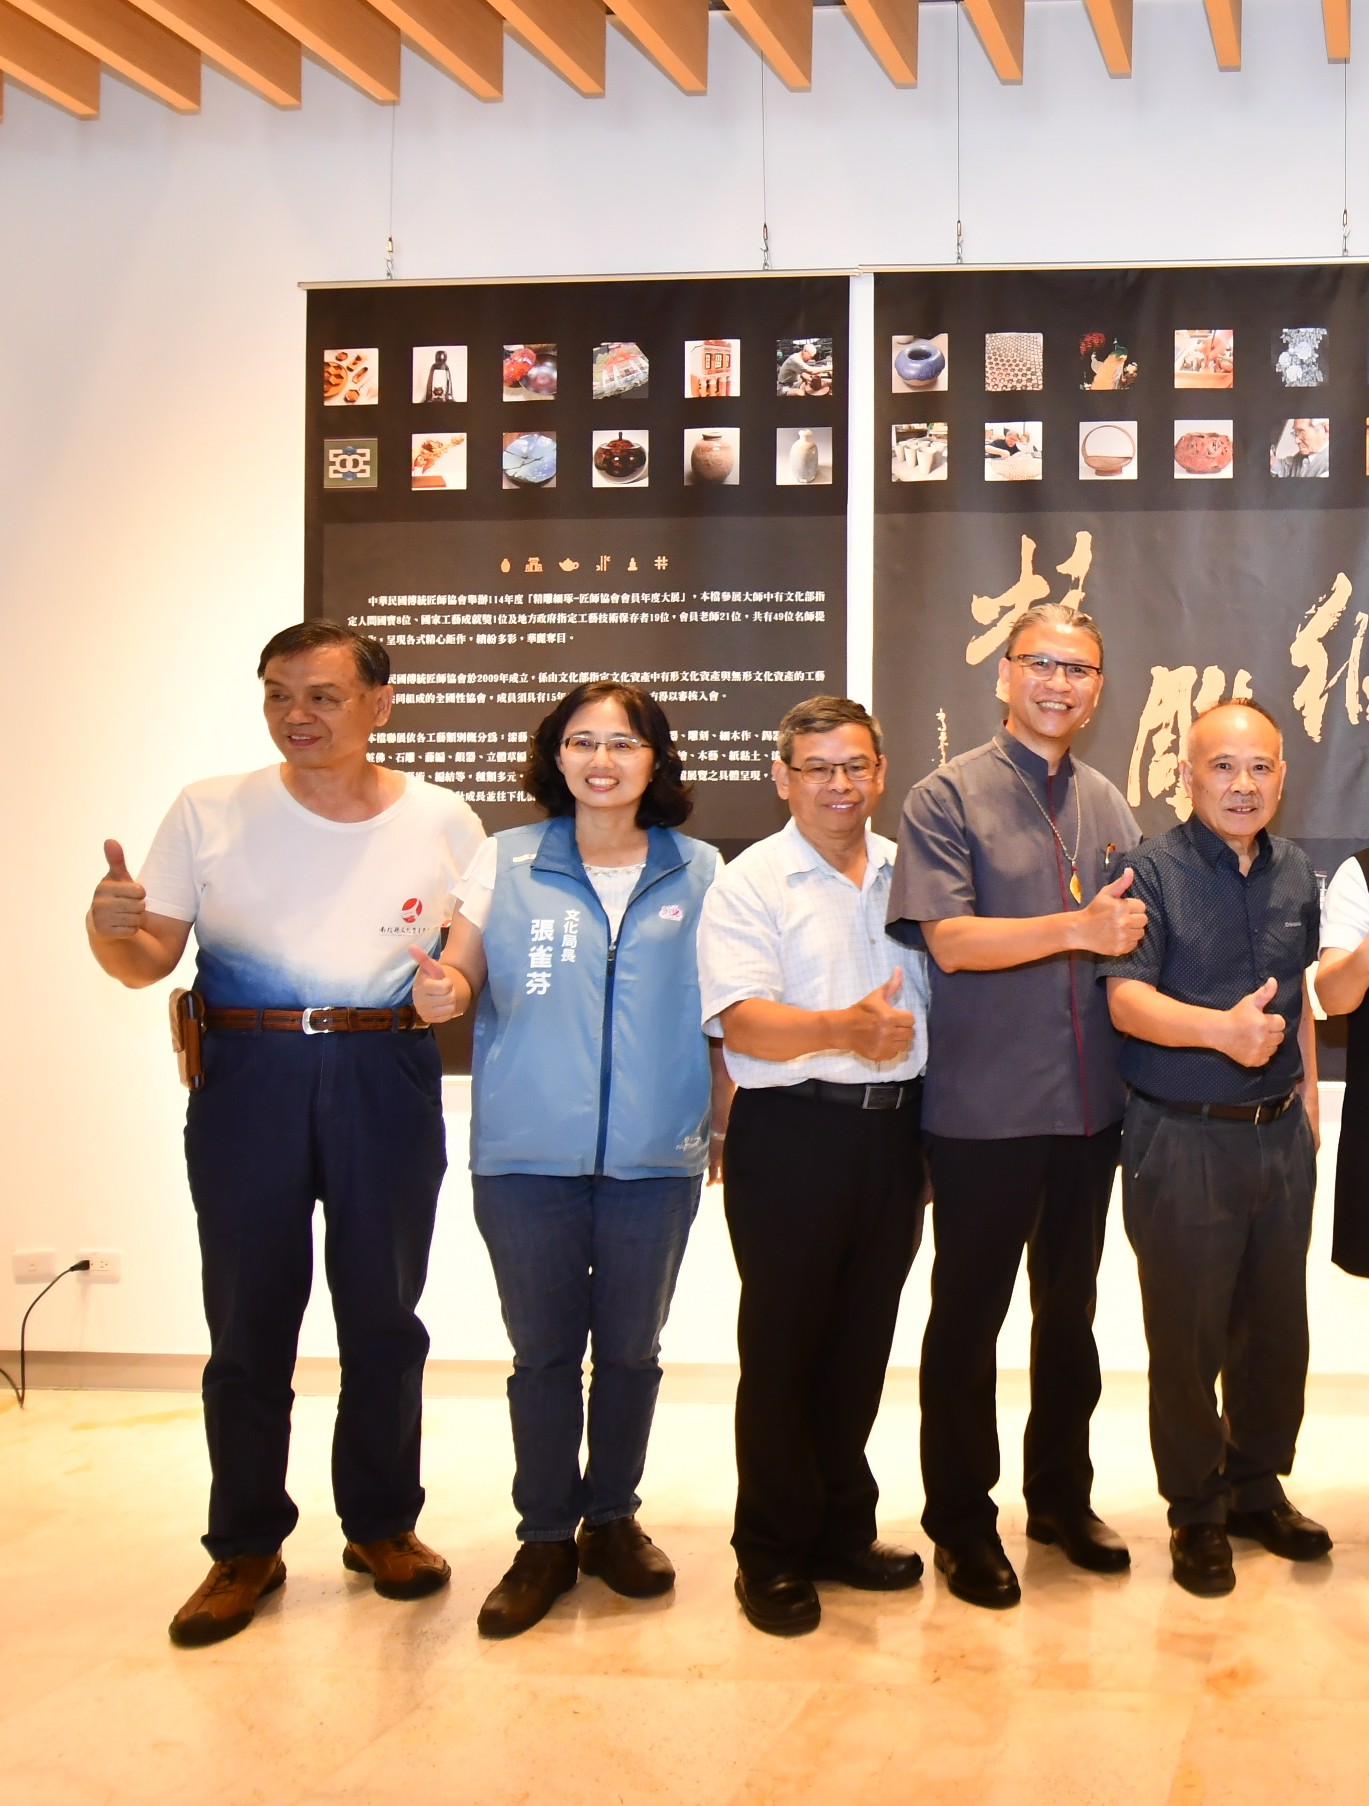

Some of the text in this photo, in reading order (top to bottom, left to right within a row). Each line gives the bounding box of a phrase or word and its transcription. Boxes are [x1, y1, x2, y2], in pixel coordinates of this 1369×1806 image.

[525, 918, 555, 996] 張雀芬
[560, 909, 581, 963] 文化局長
